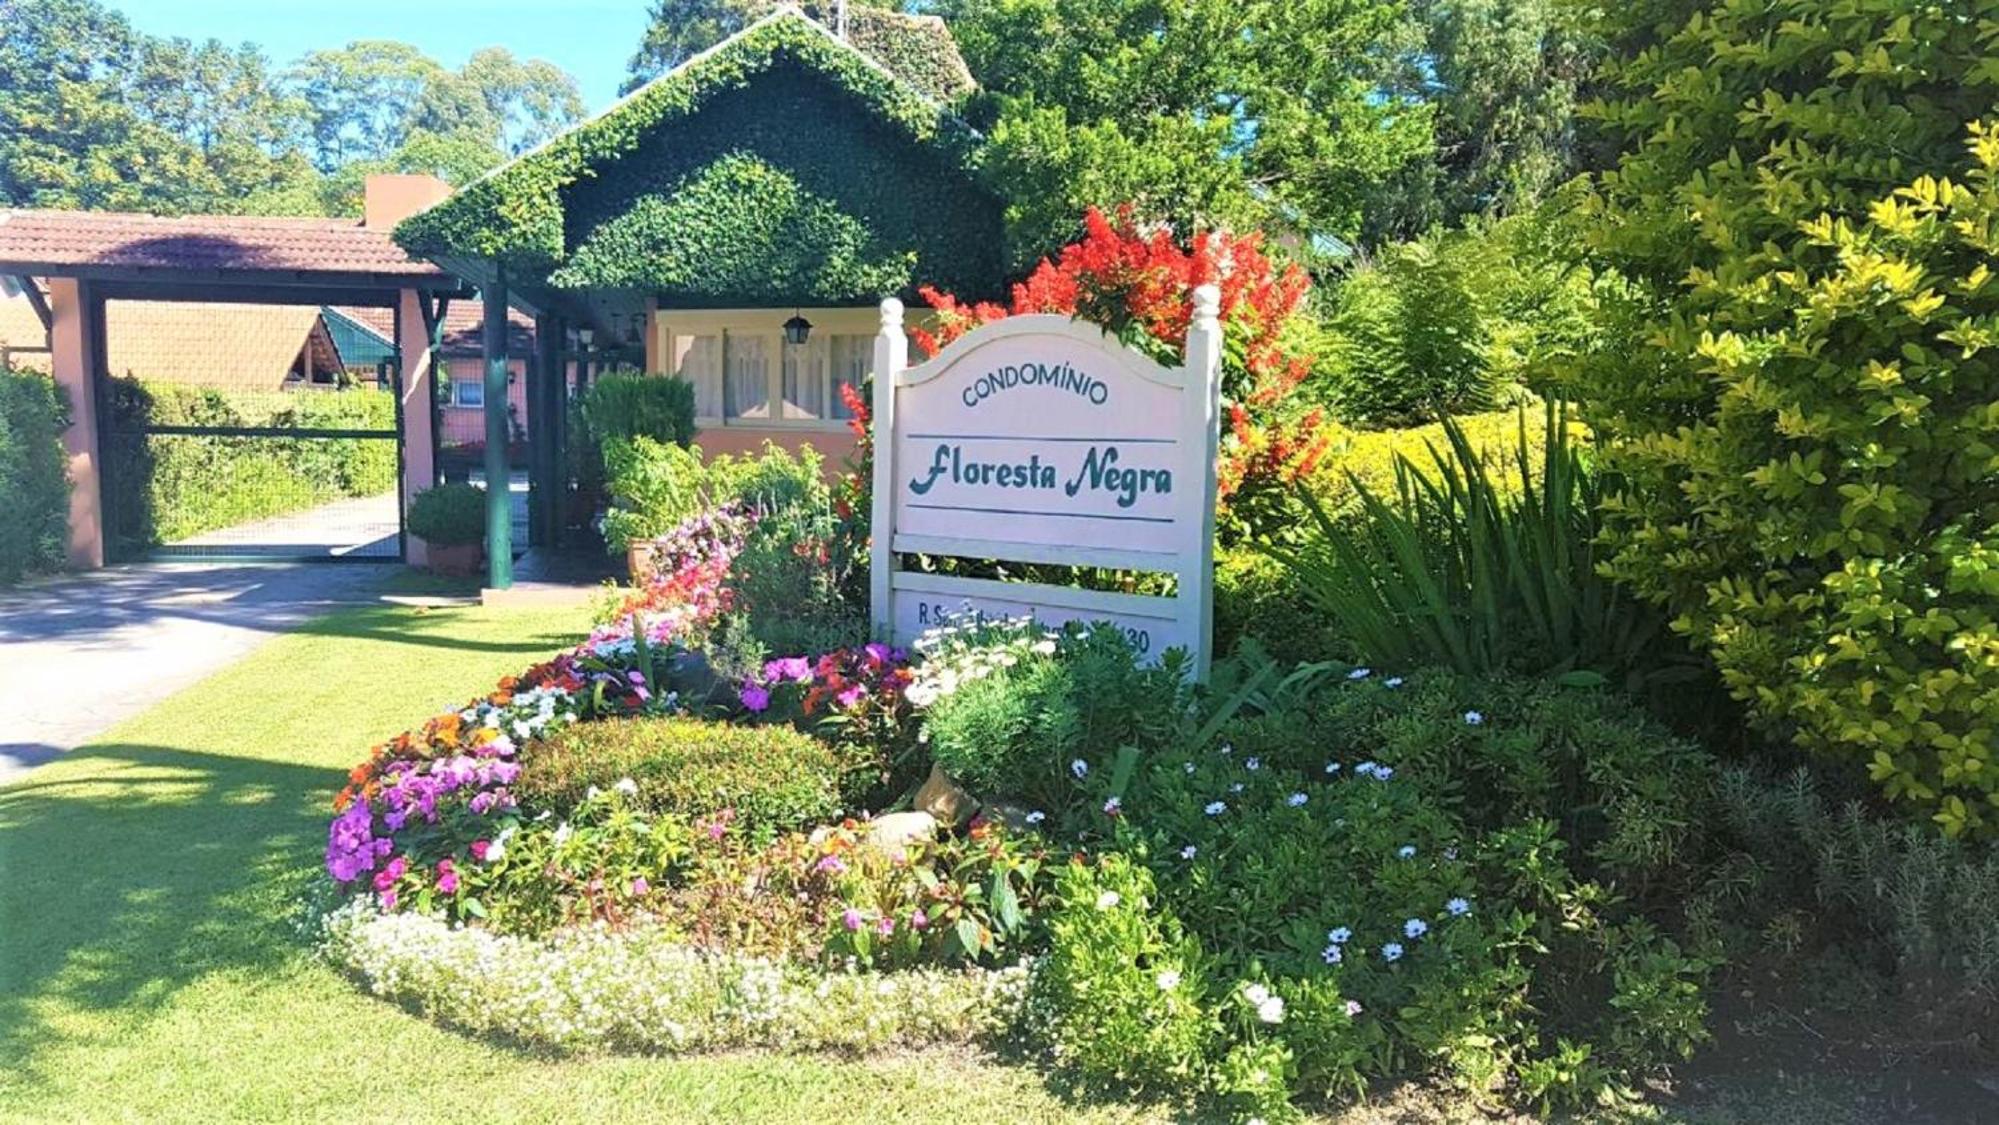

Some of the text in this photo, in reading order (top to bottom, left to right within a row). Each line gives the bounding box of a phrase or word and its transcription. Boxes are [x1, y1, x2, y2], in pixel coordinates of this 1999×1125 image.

[962, 361, 1108, 407] CONDOMÍNIO
[909, 444, 1172, 508] Floresta Negra
